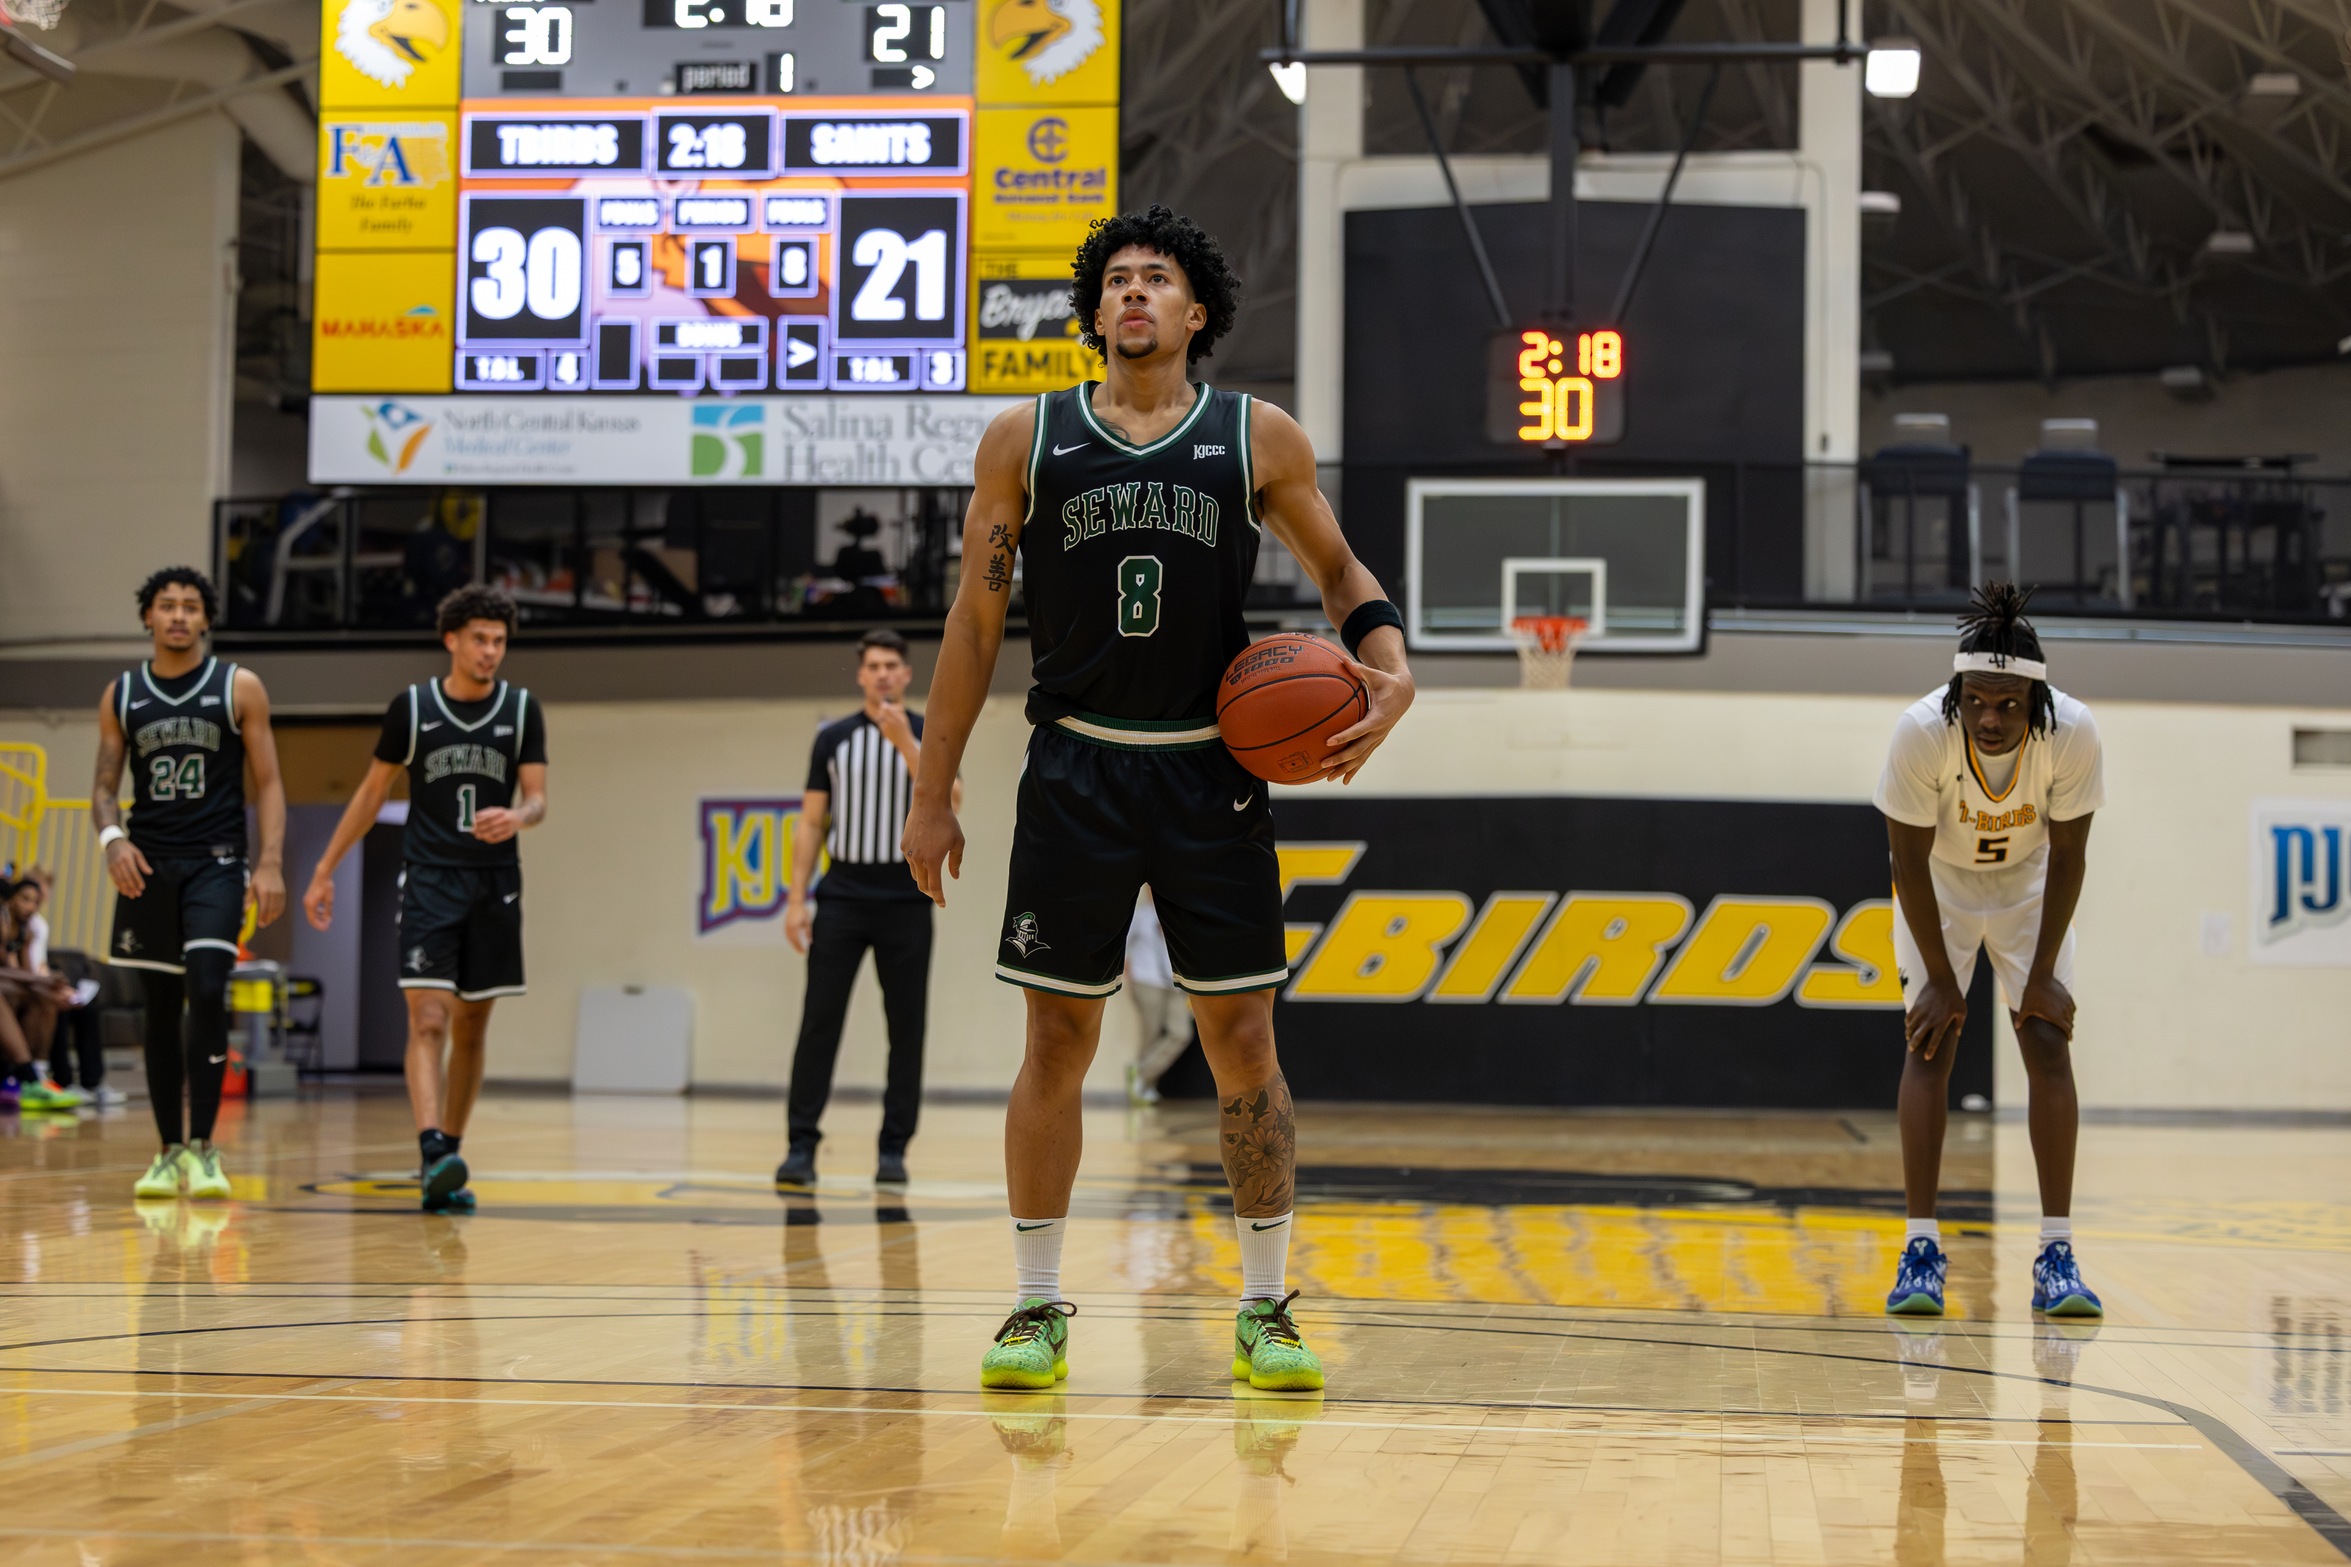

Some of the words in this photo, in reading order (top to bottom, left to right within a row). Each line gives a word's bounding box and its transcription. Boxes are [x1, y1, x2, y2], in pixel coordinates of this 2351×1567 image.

[505, 7, 573, 64] 30
[873, 4, 945, 62] 21
[780, 53, 794, 92] 1
[667, 123, 746, 168] 2:18
[995, 168, 1106, 188] Central
[473, 229, 581, 320] 30
[700, 245, 722, 288] 1
[853, 231, 946, 320] 21
[980, 284, 1074, 342] Brya
[984, 350, 1097, 379] FAMILY
[1518, 331, 1621, 378] 2:18
[783, 402, 893, 442] Salina
[905, 402, 987, 456] Regi
[1518, 377, 1593, 440] 30
[782, 443, 900, 484] Health
[911, 443, 974, 484] Ce
[1193, 445, 1226, 460] KJCCC
[1062, 482, 1219, 551] SEWARD
[983, 523, 1014, 592] 改善
[1117, 555, 1163, 637] 8
[1225, 645, 1304, 683] LEGACY
[1244, 656, 1294, 675] 1000
[136, 716, 221, 758] SEWARD
[149, 753, 205, 801] 24
[457, 784, 476, 832] 1
[1973, 836, 2010, 864] 5
[2269, 824, 2351, 929] NJ
